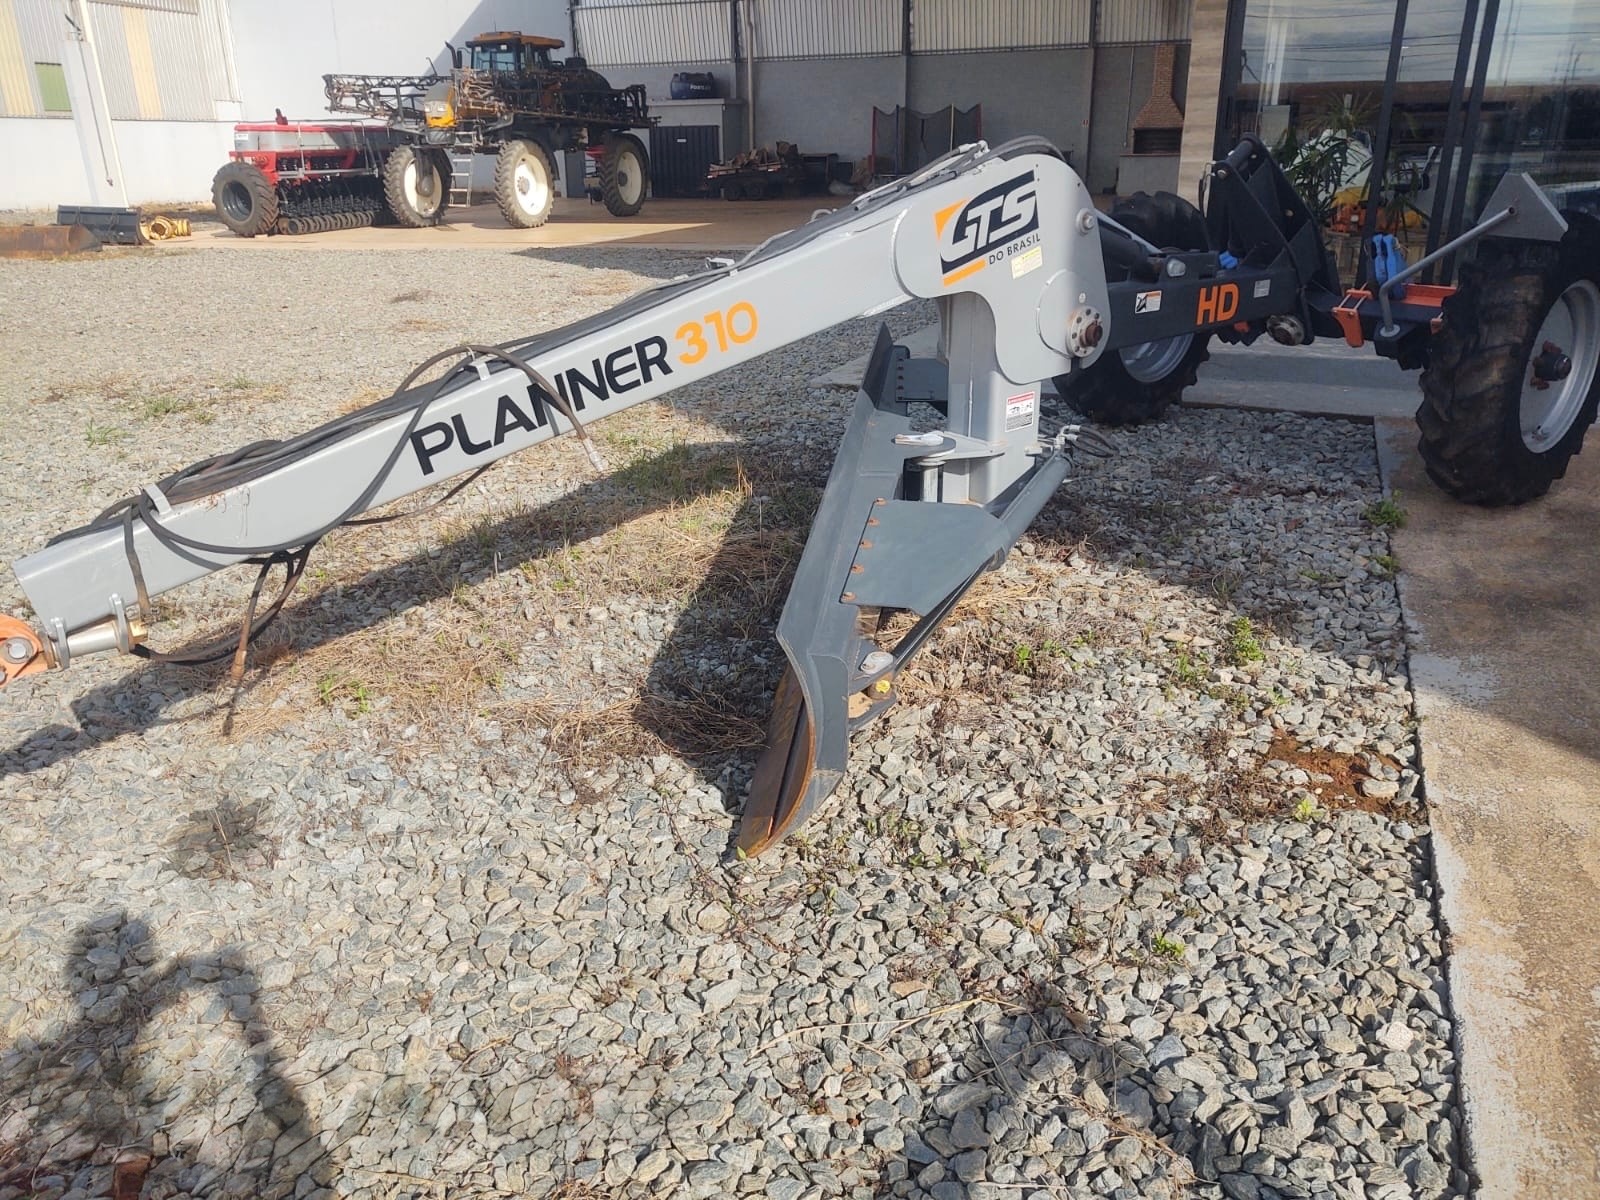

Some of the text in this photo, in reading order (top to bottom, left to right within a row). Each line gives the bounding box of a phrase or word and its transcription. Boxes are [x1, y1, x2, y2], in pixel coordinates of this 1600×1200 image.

[940, 181, 1037, 263] GTS
[989, 251, 1004, 265] DO
[1007, 233, 1041, 256] BRASIL
[1196, 283, 1239, 325] HD
[410, 301, 758, 475] PLANNER 310
